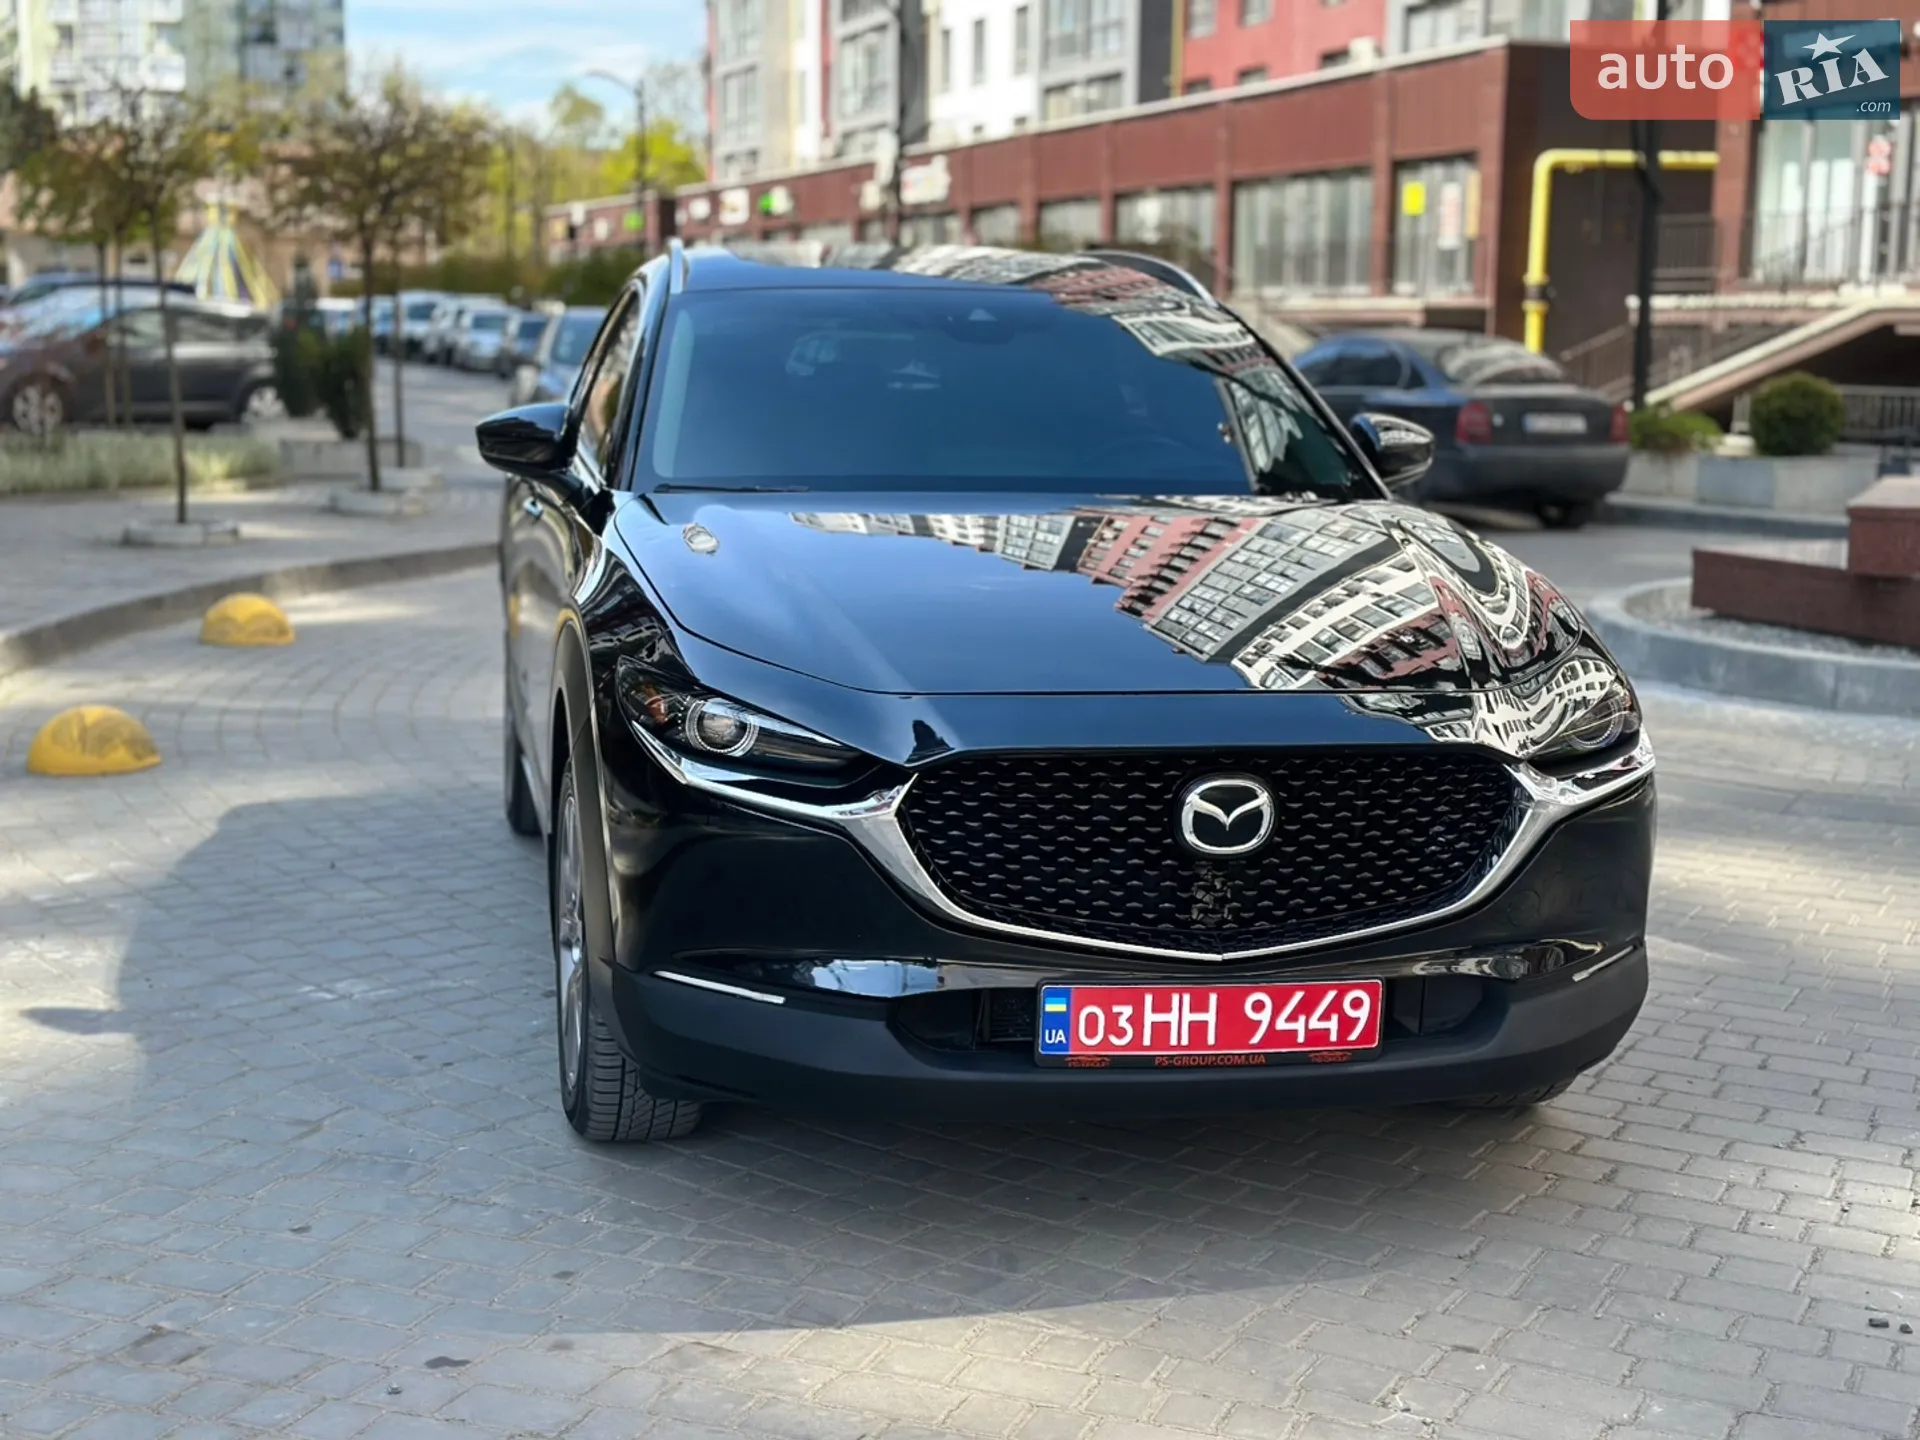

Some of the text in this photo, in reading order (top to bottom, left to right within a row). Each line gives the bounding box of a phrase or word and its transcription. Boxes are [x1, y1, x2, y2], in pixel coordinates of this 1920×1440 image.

[1243, 989, 1371, 1045] 9449
[1045, 1029, 1067, 1045] UA
[1154, 1054, 1266, 1067] PS-GROUP.COM.UA
